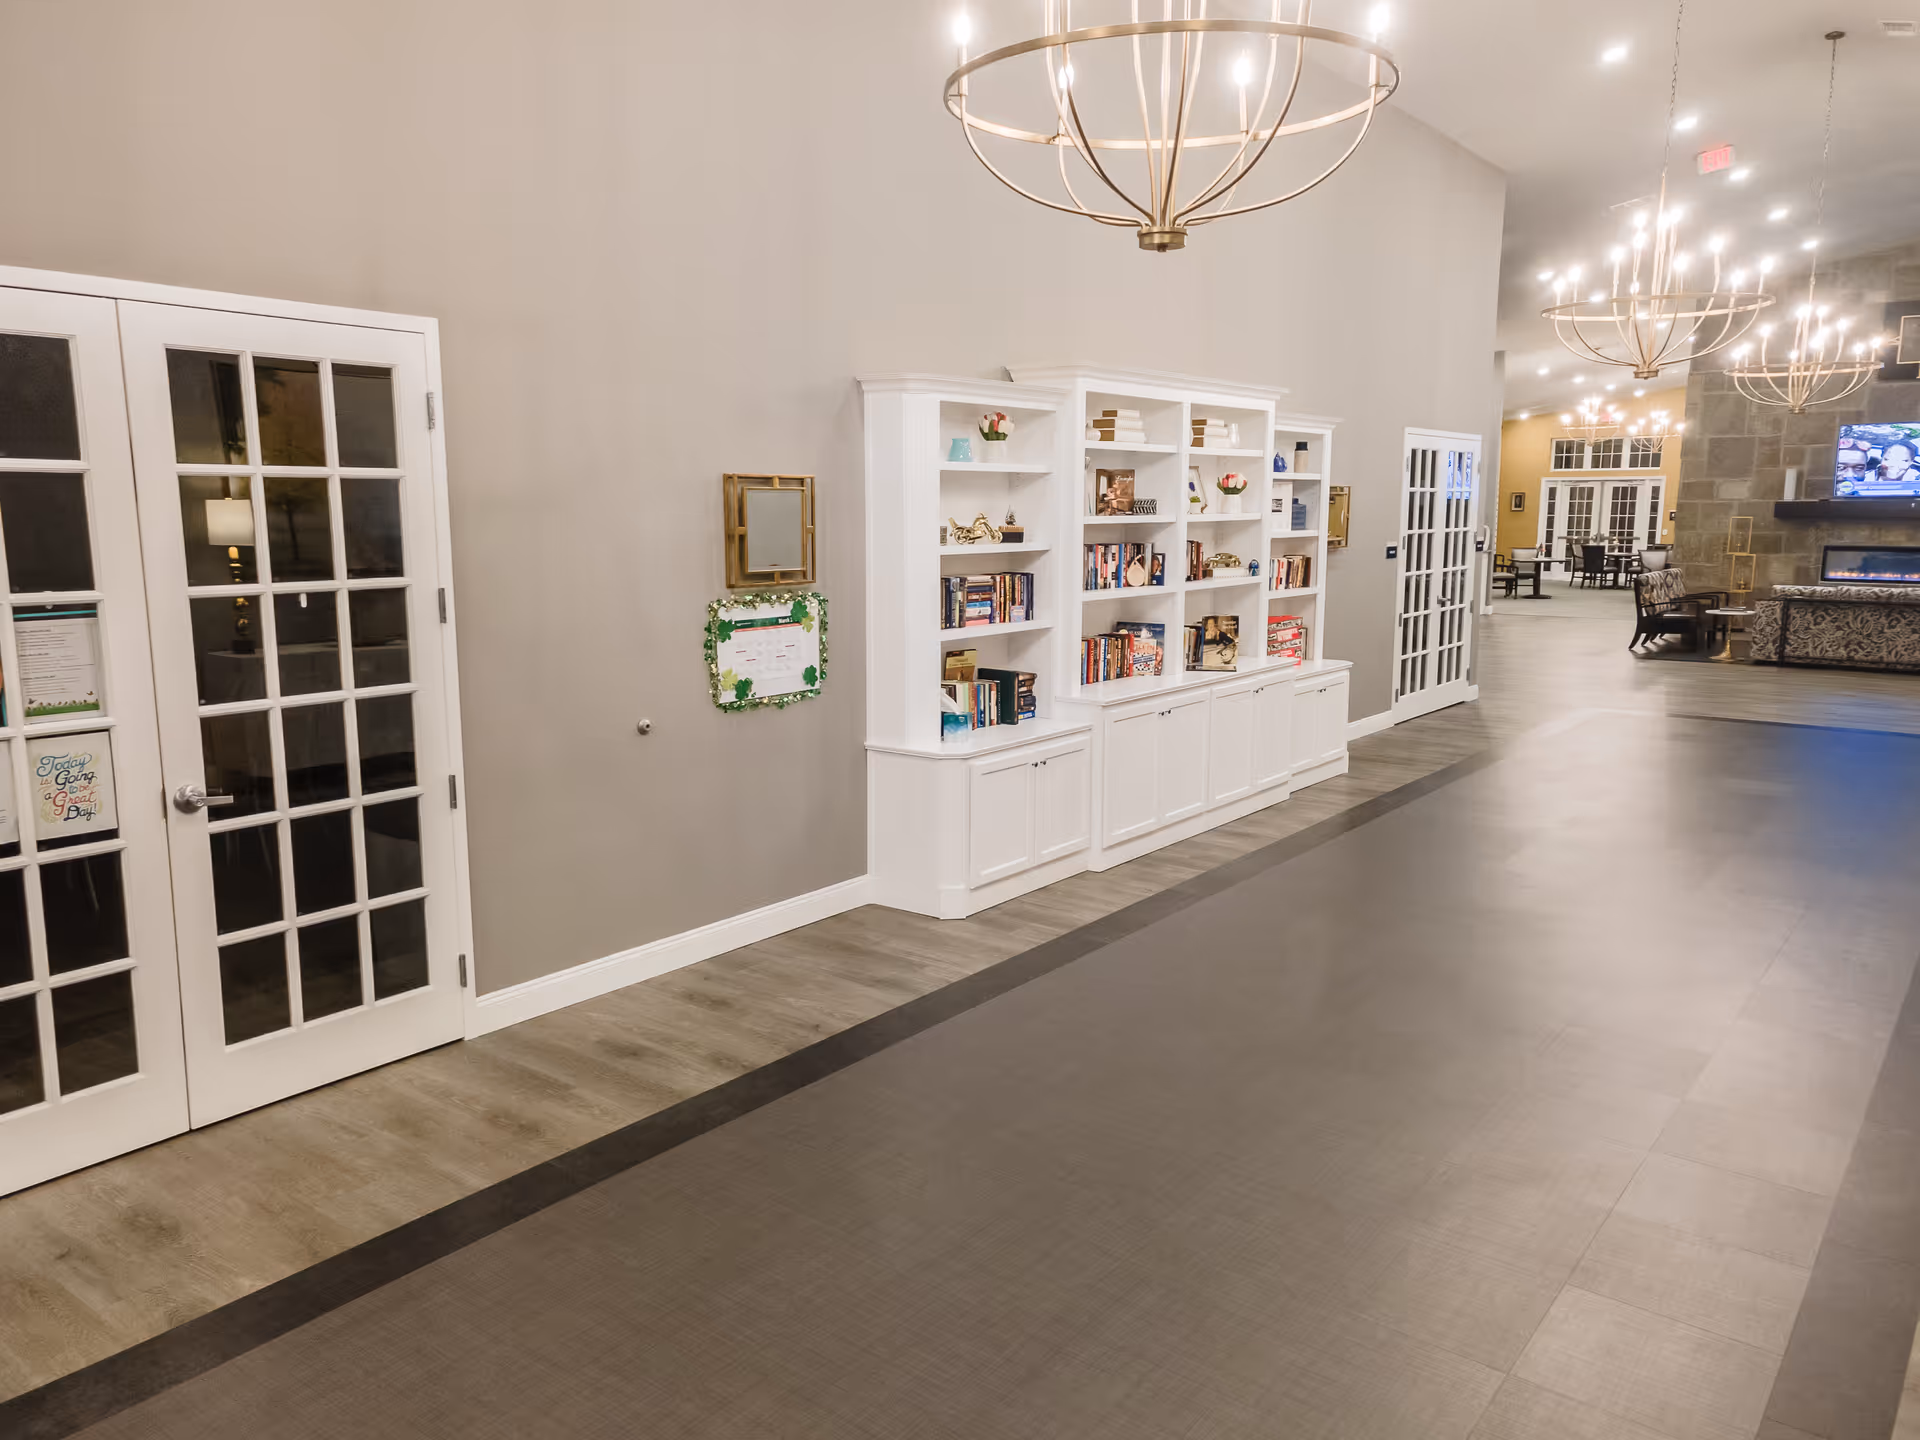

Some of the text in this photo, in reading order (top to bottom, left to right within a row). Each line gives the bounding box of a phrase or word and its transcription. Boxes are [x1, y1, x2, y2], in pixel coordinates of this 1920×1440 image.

[1703, 147, 1731, 172] EXIT
[36, 752, 92, 777] Today
[40, 769, 97, 791] is Going
[69, 784, 90, 794] to be
[44, 791, 97, 816] a Great
[63, 802, 97, 822] Day!
